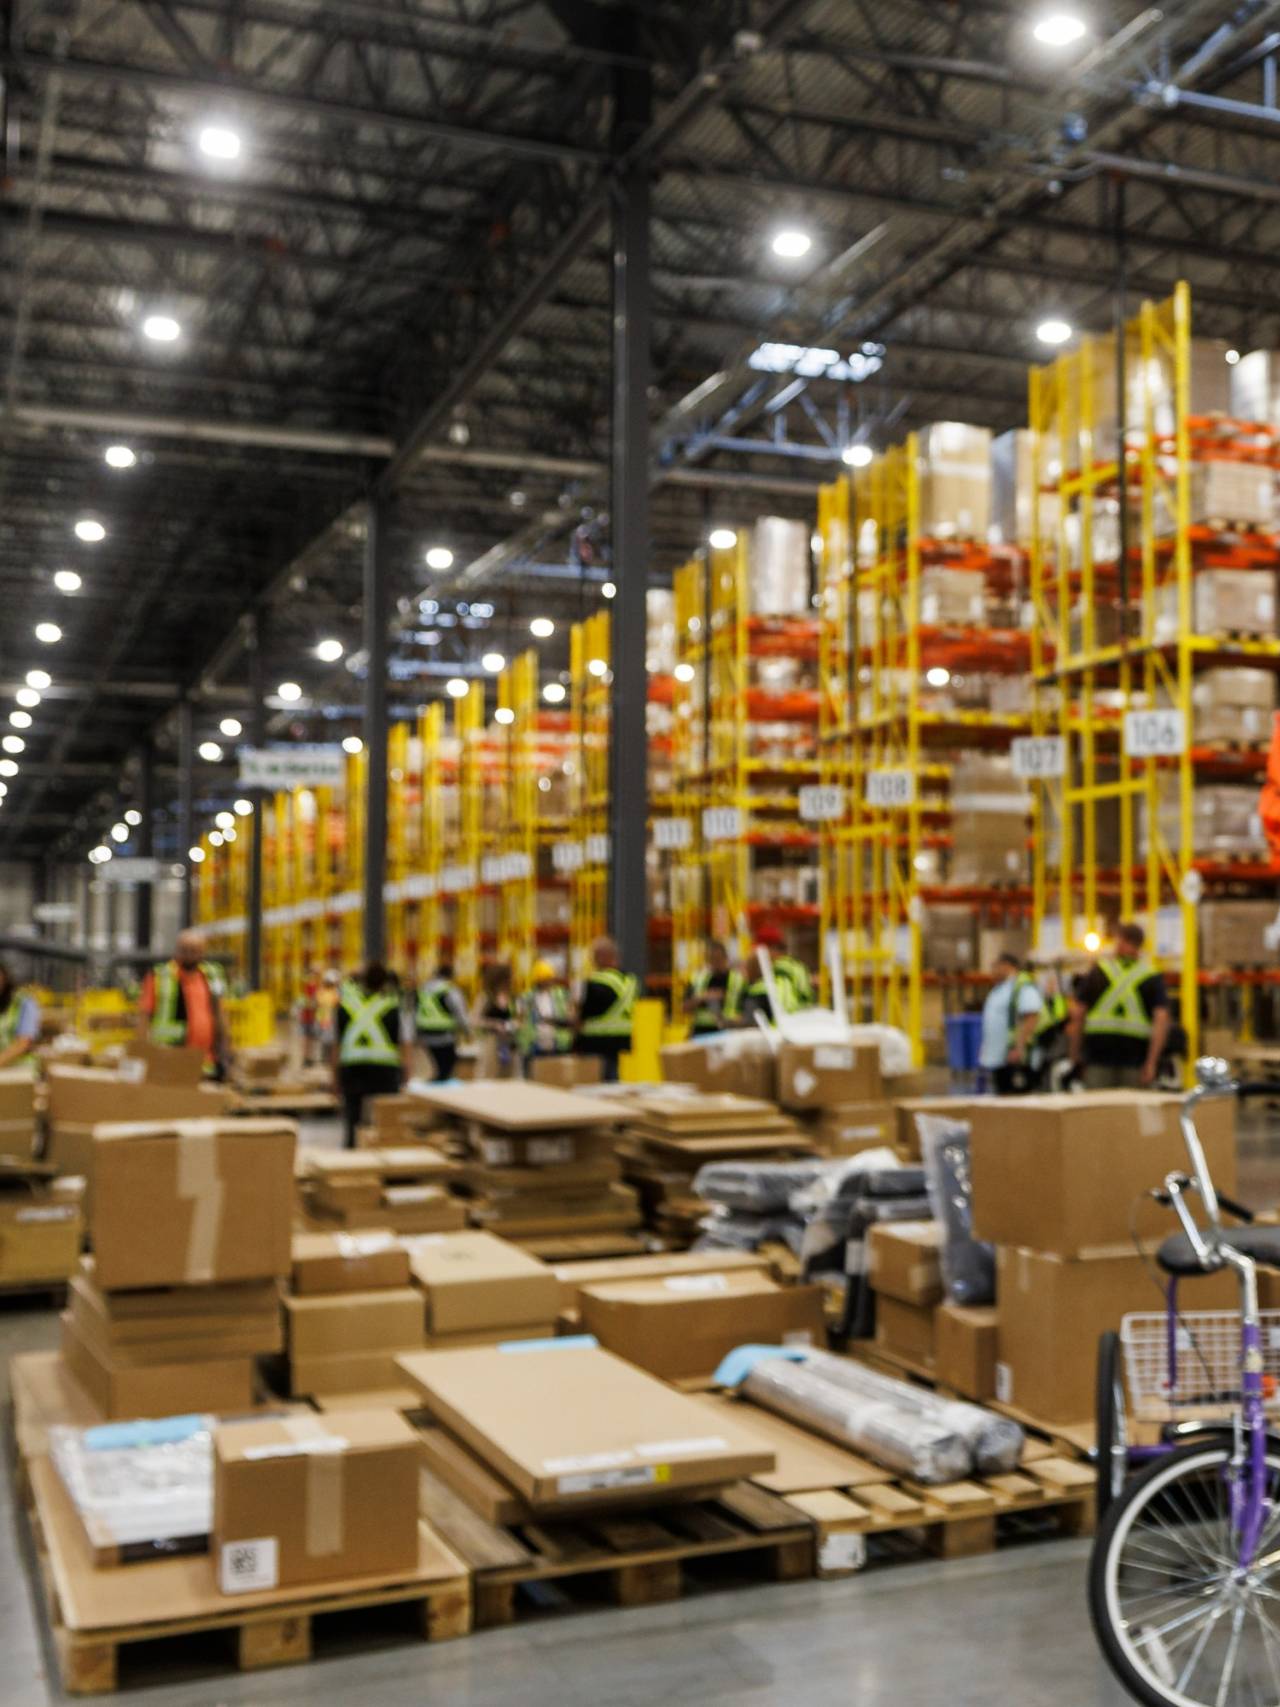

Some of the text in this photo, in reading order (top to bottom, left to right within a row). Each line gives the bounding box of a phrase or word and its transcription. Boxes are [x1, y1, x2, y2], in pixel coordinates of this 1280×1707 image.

[1134, 719, 1175, 745] 106
[1020, 742, 1057, 769] 107
[872, 776, 907, 801] 108
